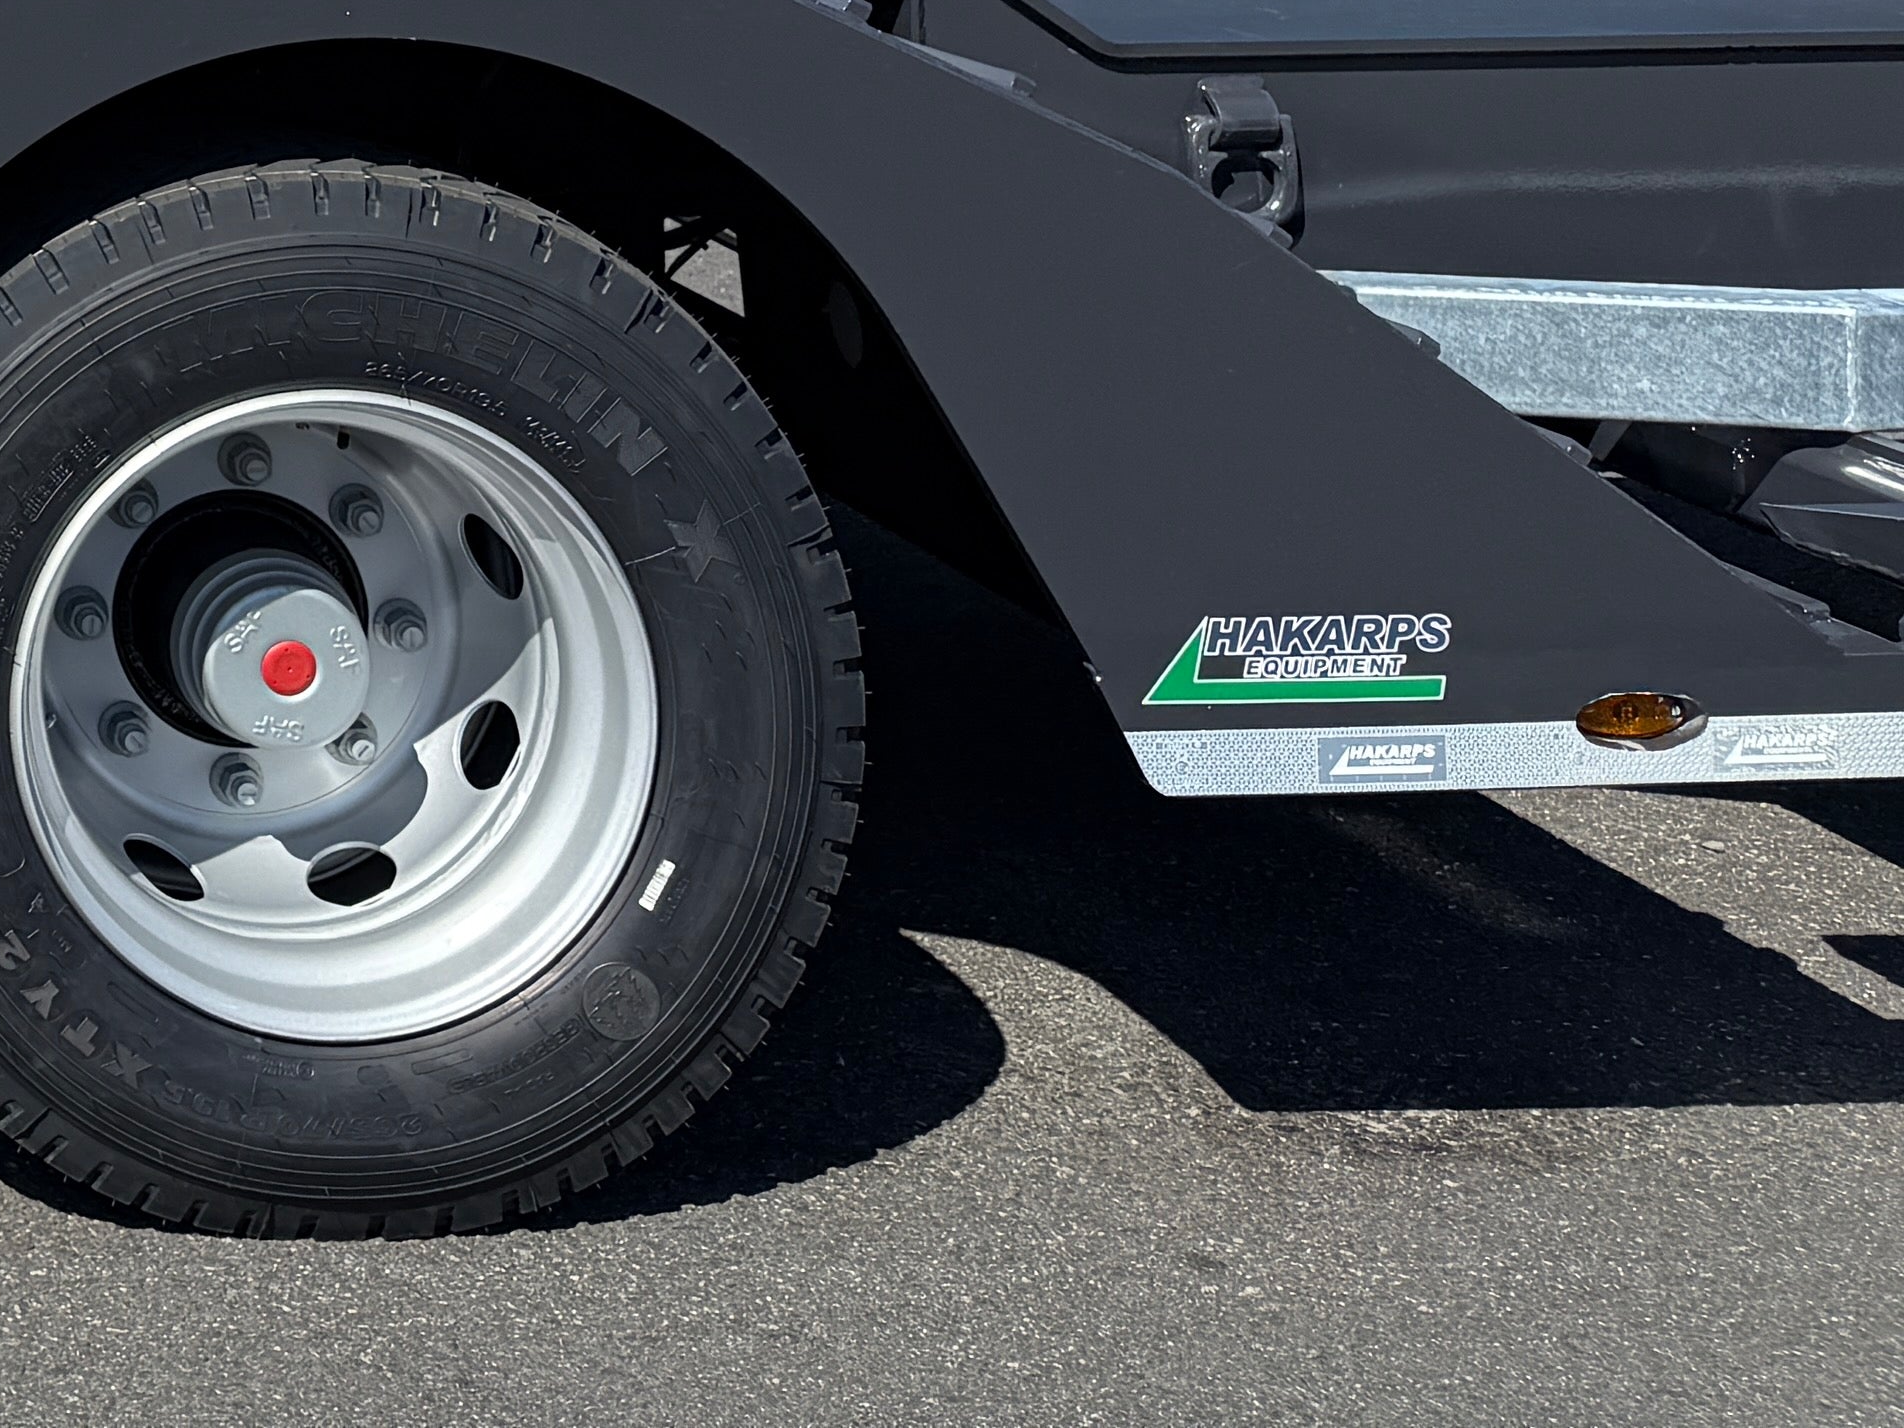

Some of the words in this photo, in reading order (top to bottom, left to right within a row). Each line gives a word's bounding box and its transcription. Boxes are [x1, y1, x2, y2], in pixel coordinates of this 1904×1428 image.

[224, 610, 262, 653] SAF
[1203, 613, 1453, 657] HAKARPS
[1242, 654, 1407, 679] EQUIPMENT
[252, 715, 304, 741] SAF
[1349, 743, 1437, 760] HAKARPS
